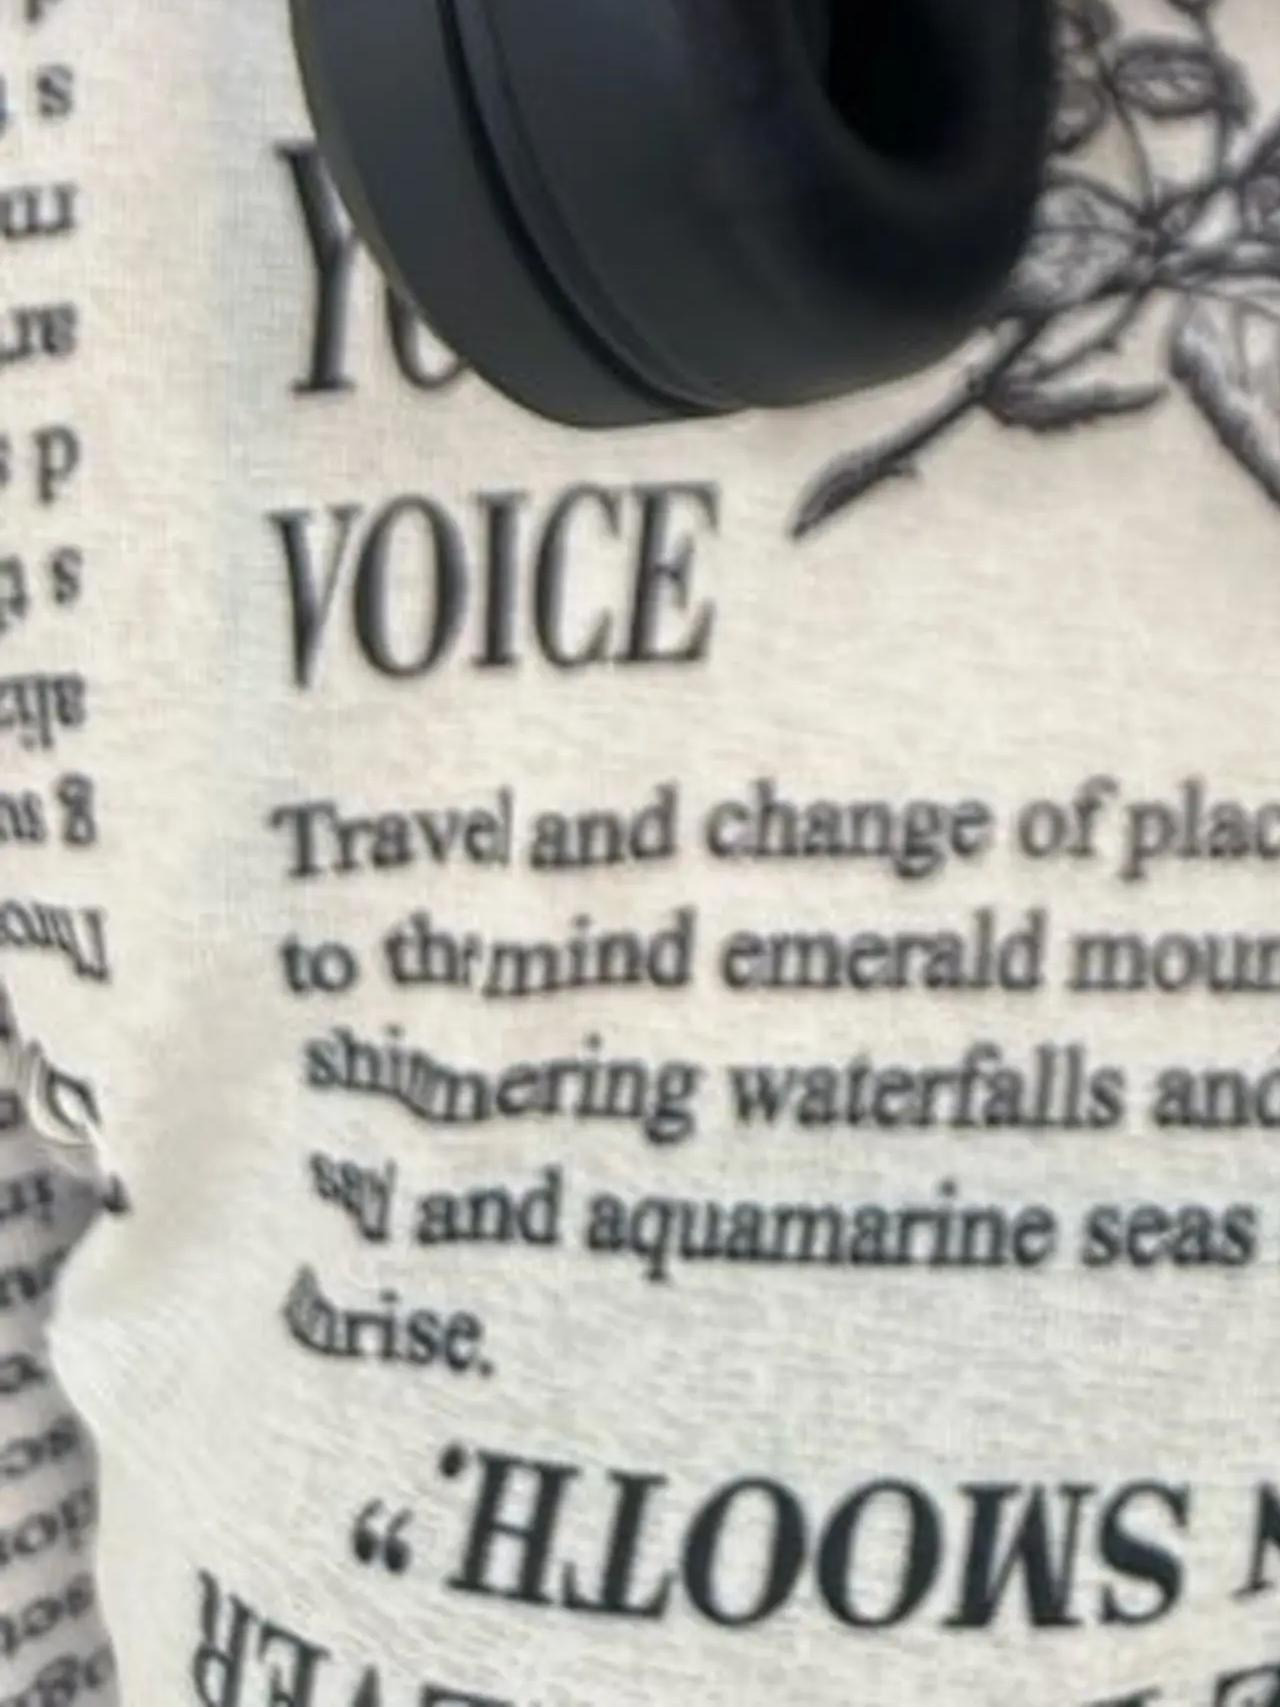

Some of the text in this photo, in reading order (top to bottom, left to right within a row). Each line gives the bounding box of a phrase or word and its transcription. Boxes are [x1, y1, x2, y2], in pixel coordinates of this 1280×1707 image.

[270, 480, 719, 689] VOICE
[269, 791, 509, 881] Travel
[528, 782, 677, 868] and
[706, 778, 988, 879] change
[1017, 776, 1115, 861] of
[279, 930, 358, 994] to
[483, 903, 697, 999] mind
[720, 906, 1044, 992] emerald
[728, 1043, 1124, 1133] waterfalls
[414, 1162, 566, 1246] and
[585, 1181, 1053, 1281] aquamarine
[1081, 1199, 1257, 1271] seas
